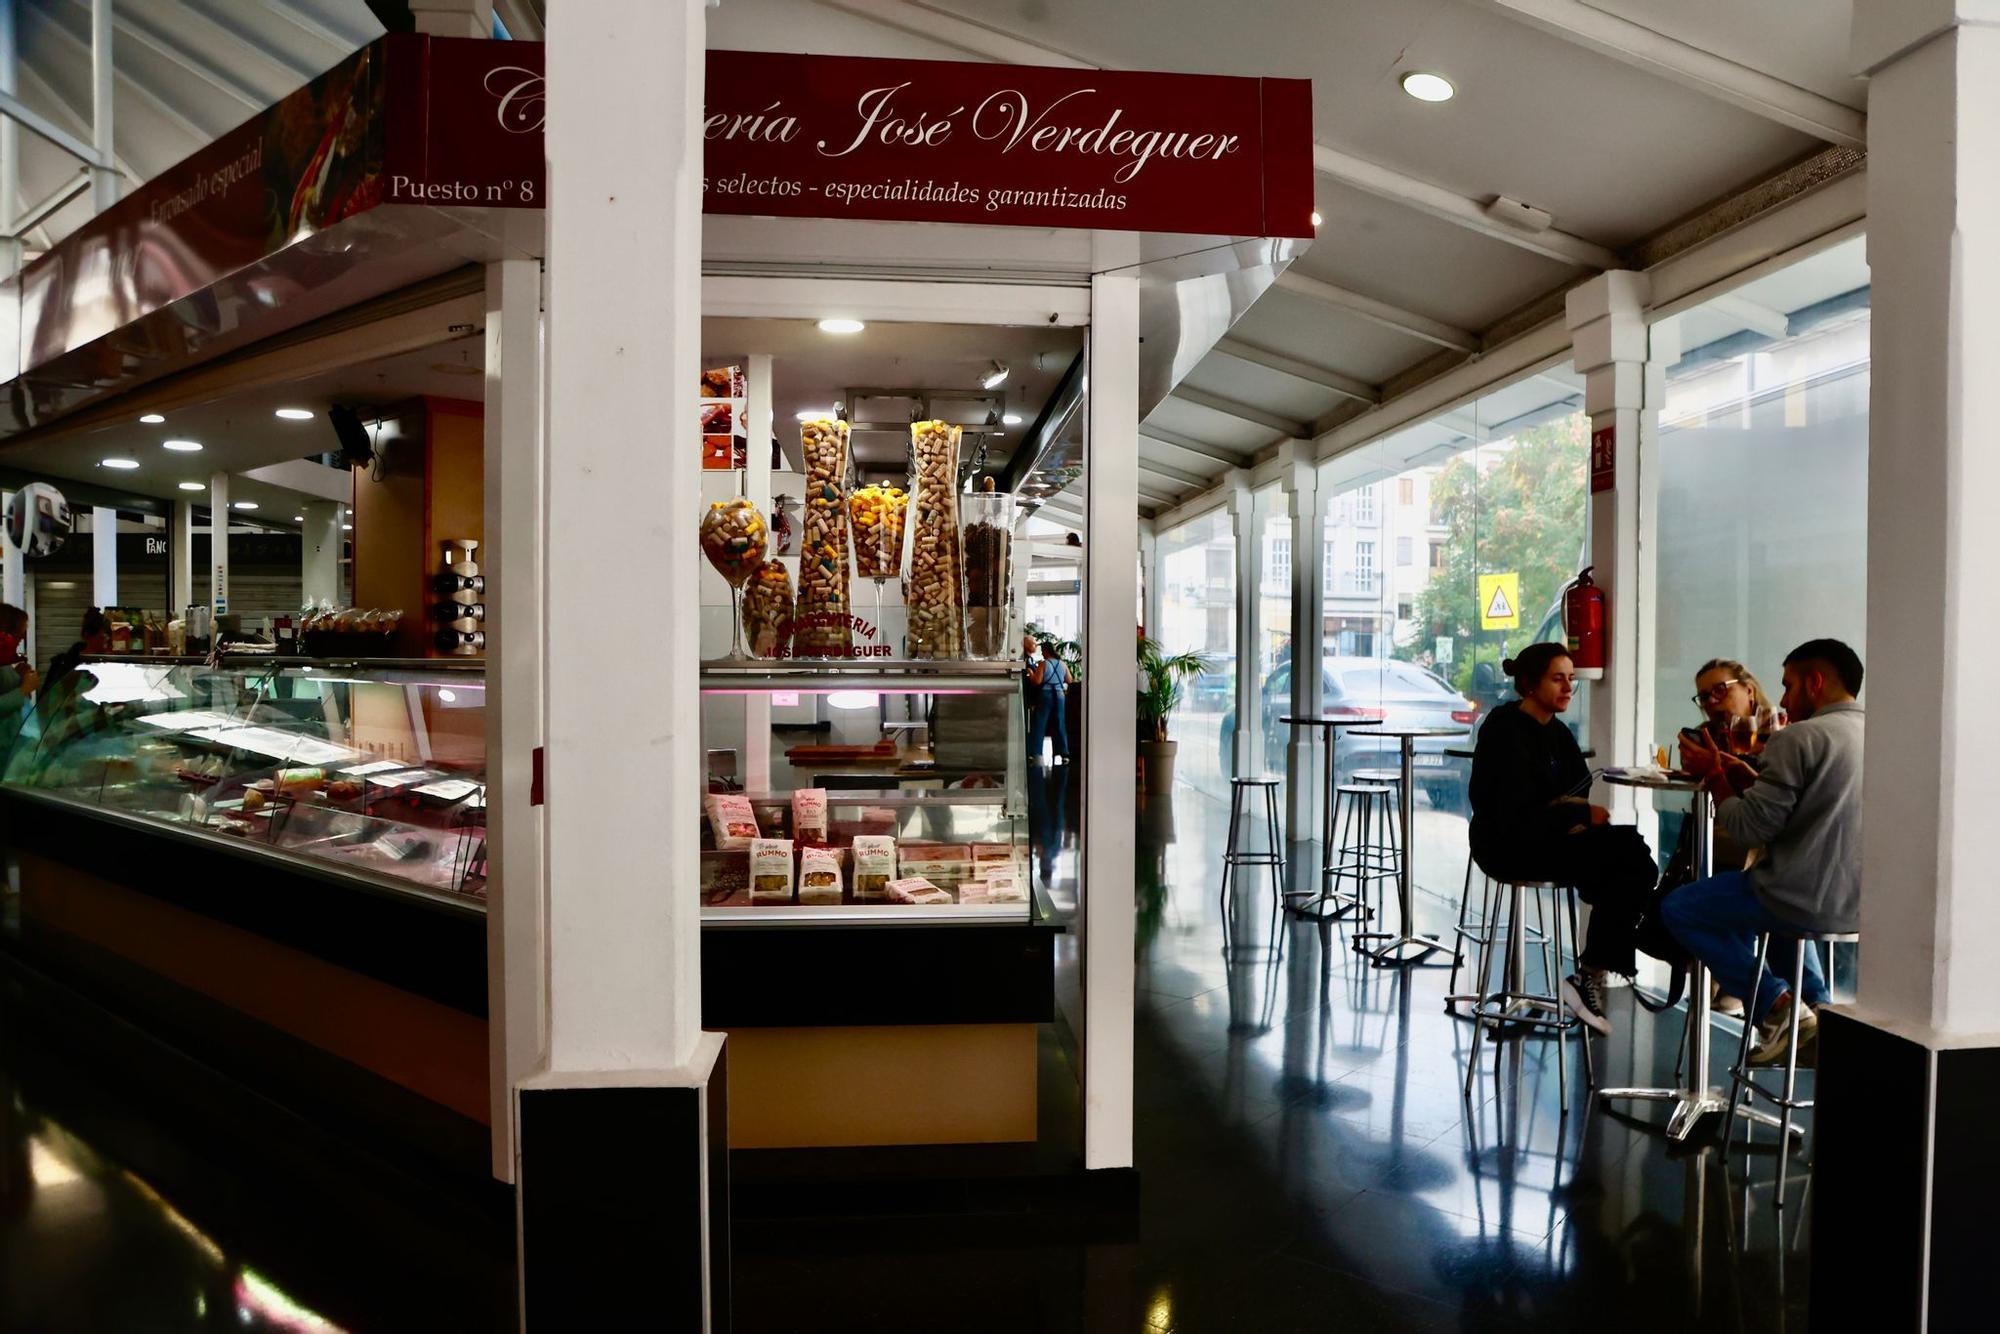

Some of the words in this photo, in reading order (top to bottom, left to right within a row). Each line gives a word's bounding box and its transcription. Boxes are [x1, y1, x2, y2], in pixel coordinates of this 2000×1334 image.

[484, 66, 546, 133] C
[703, 101, 802, 143] ería
[817, 81, 965, 157] José
[972, 89, 1239, 184] Verdeguer
[211, 136, 262, 198] especial
[392, 175, 478, 200] Puesto
[520, 180, 534, 201] 8
[717, 173, 802, 196] selectos
[825, 179, 979, 205] especialidades
[986, 186, 1127, 212] garantizadas
[756, 849, 788, 858] RUMMO
[858, 848, 889, 857] RUMMO
